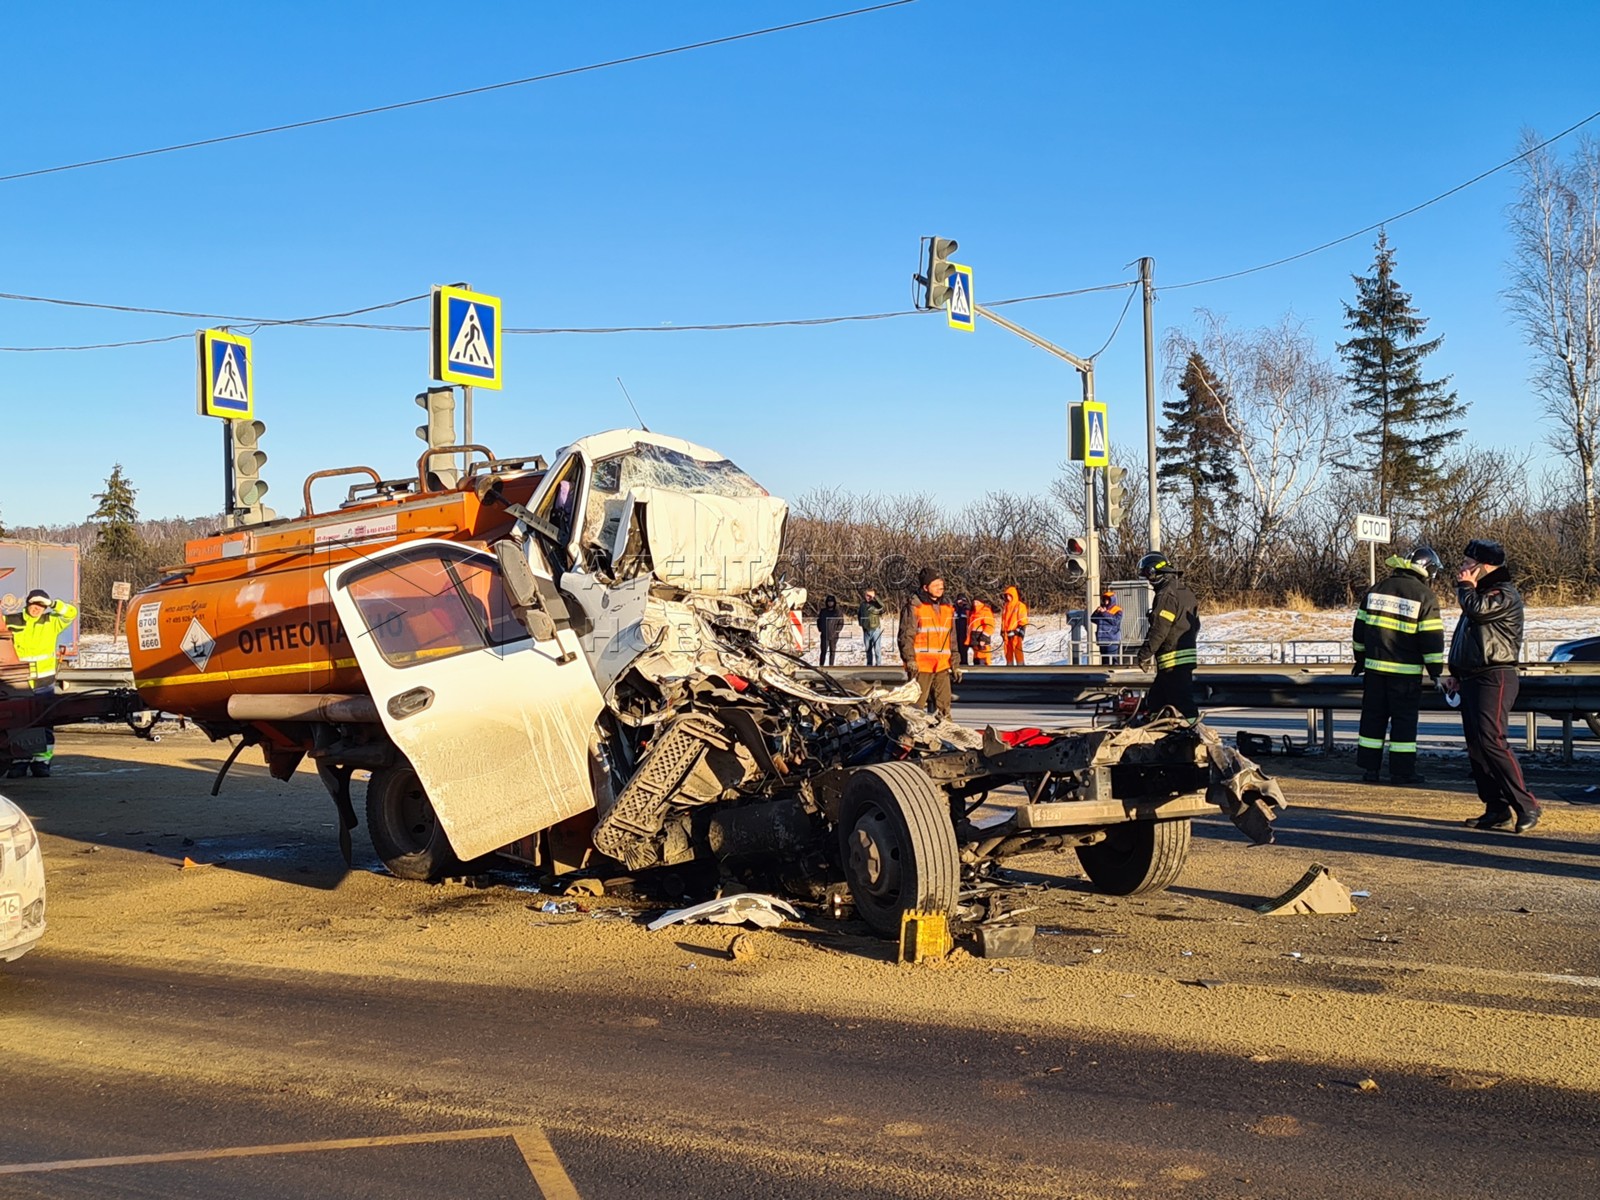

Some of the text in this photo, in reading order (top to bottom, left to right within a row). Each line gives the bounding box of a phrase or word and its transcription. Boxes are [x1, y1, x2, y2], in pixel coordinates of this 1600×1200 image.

[1362, 519, 1387, 538] СТОП
[138, 617, 157, 627] 8700
[141, 638, 159, 648] 4660
